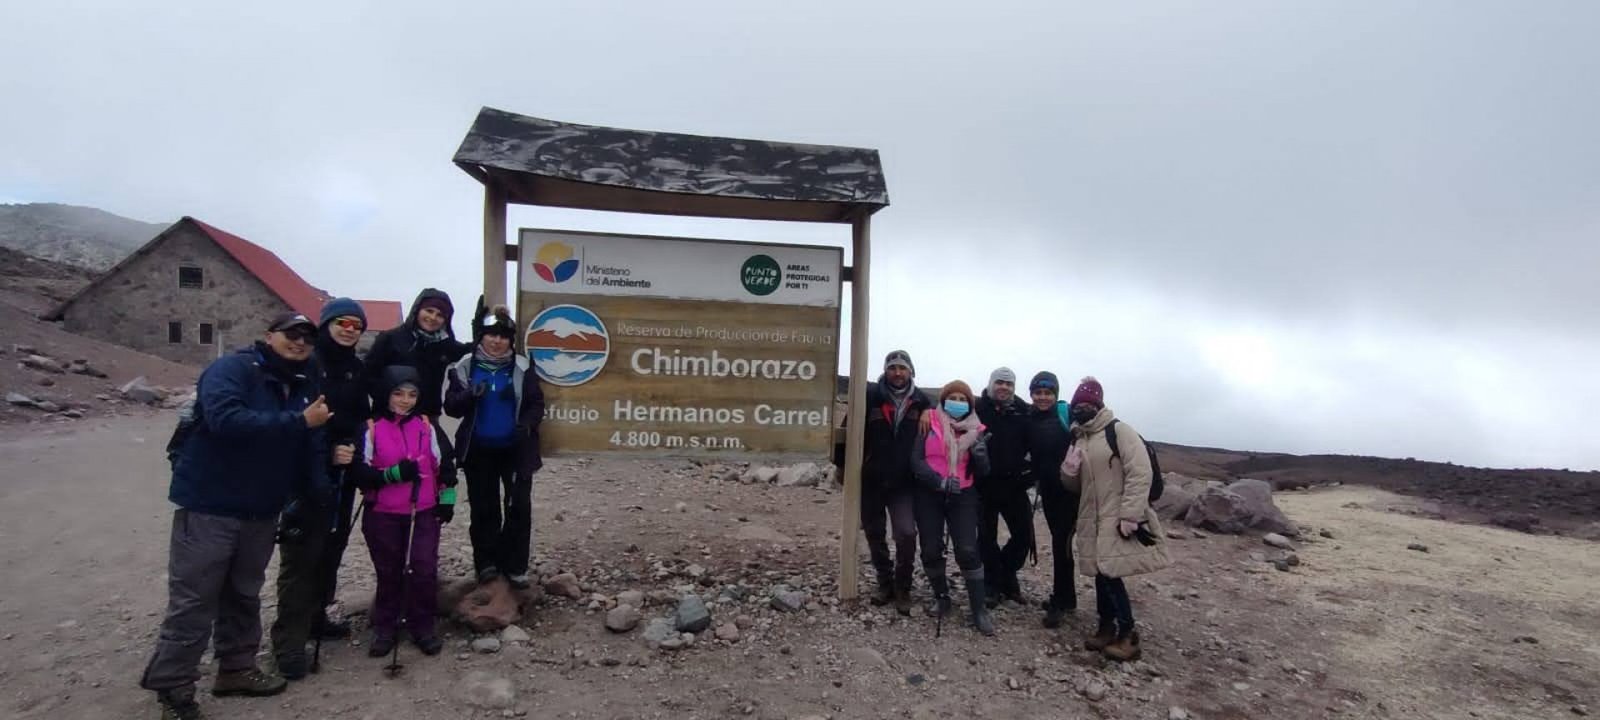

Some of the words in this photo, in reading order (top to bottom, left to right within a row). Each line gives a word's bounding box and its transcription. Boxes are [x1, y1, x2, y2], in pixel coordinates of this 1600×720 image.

[745, 266, 777, 277] PUNTO
[601, 277, 652, 289] Ambiente
[744, 275, 777, 286] VERDE
[785, 273, 831, 283] PROTEGIDAS
[785, 282, 800, 290] POR
[801, 283, 809, 291] TI
[617, 322, 671, 337] Reserva
[674, 325, 692, 338] de
[769, 330, 788, 343] de
[631, 347, 817, 381] Chimborazo
[542, 404, 600, 425] fugio
[613, 399, 746, 424] Hermanos
[753, 403, 828, 427] Carrel
[609, 430, 661, 447] 4.800
[665, 434, 745, 449] m.s.n.m.
